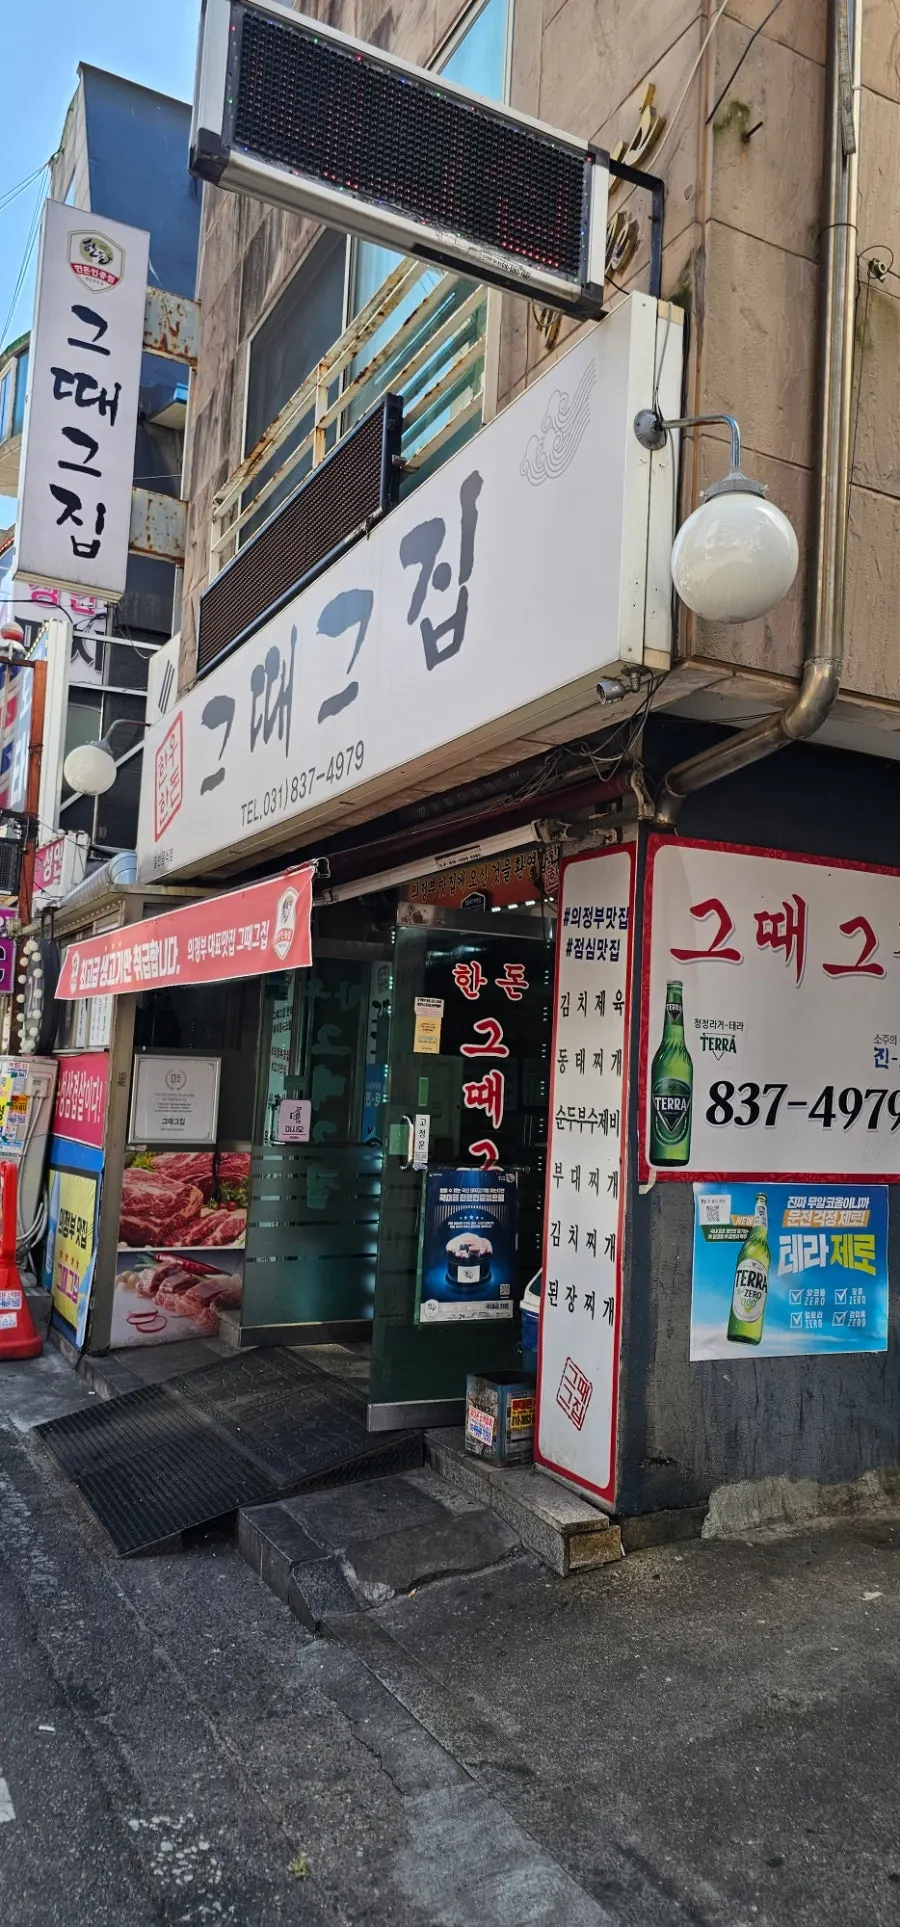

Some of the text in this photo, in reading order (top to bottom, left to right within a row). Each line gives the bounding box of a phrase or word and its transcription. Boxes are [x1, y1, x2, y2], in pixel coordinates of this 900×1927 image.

[50, 304, 122, 560] 그때그집
[200, 470, 484, 796] 그때그집
[468, 864, 488, 889] 오신
[491, 855, 511, 888] 것을
[563, 905, 629, 930] #의정부맛집
[566, 937, 620, 962] #점심맛집
[670, 894, 900, 986] 그때그
[79, 956, 101, 991] 최고급
[100, 947, 132, 988] 생고기만
[187, 936, 208, 963] 의정부
[207, 927, 236, 958] 대표맛집
[236, 920, 270, 951] 그때그집
[452, 960, 529, 1001] 한돈
[700, 1035, 737, 1053] TERRA
[874, 1034, 897, 1046] 소주의
[655, 1096, 688, 1112] TERRA
[418, 1117, 427, 1150] 고정문
[787, 1196, 870, 1209] 진짜 무알코올이니까
[58, 1208, 88, 1250] 의정부 맛집
[788, 1210, 865, 1227] 운전 걱정 제로!
[776, 1234, 877, 1277] 테라 제로
[735, 1269, 768, 1293] TERRA
[744, 1288, 762, 1300] ZERO
[804, 1297, 826, 1306] ZERO
[806, 1289, 826, 1297] 알코올
[849, 1296, 866, 1304] ZERO
[852, 1288, 863, 1296] 당류
[805, 1319, 823, 1328] ZERO
[848, 1318, 866, 1327] ZERO
